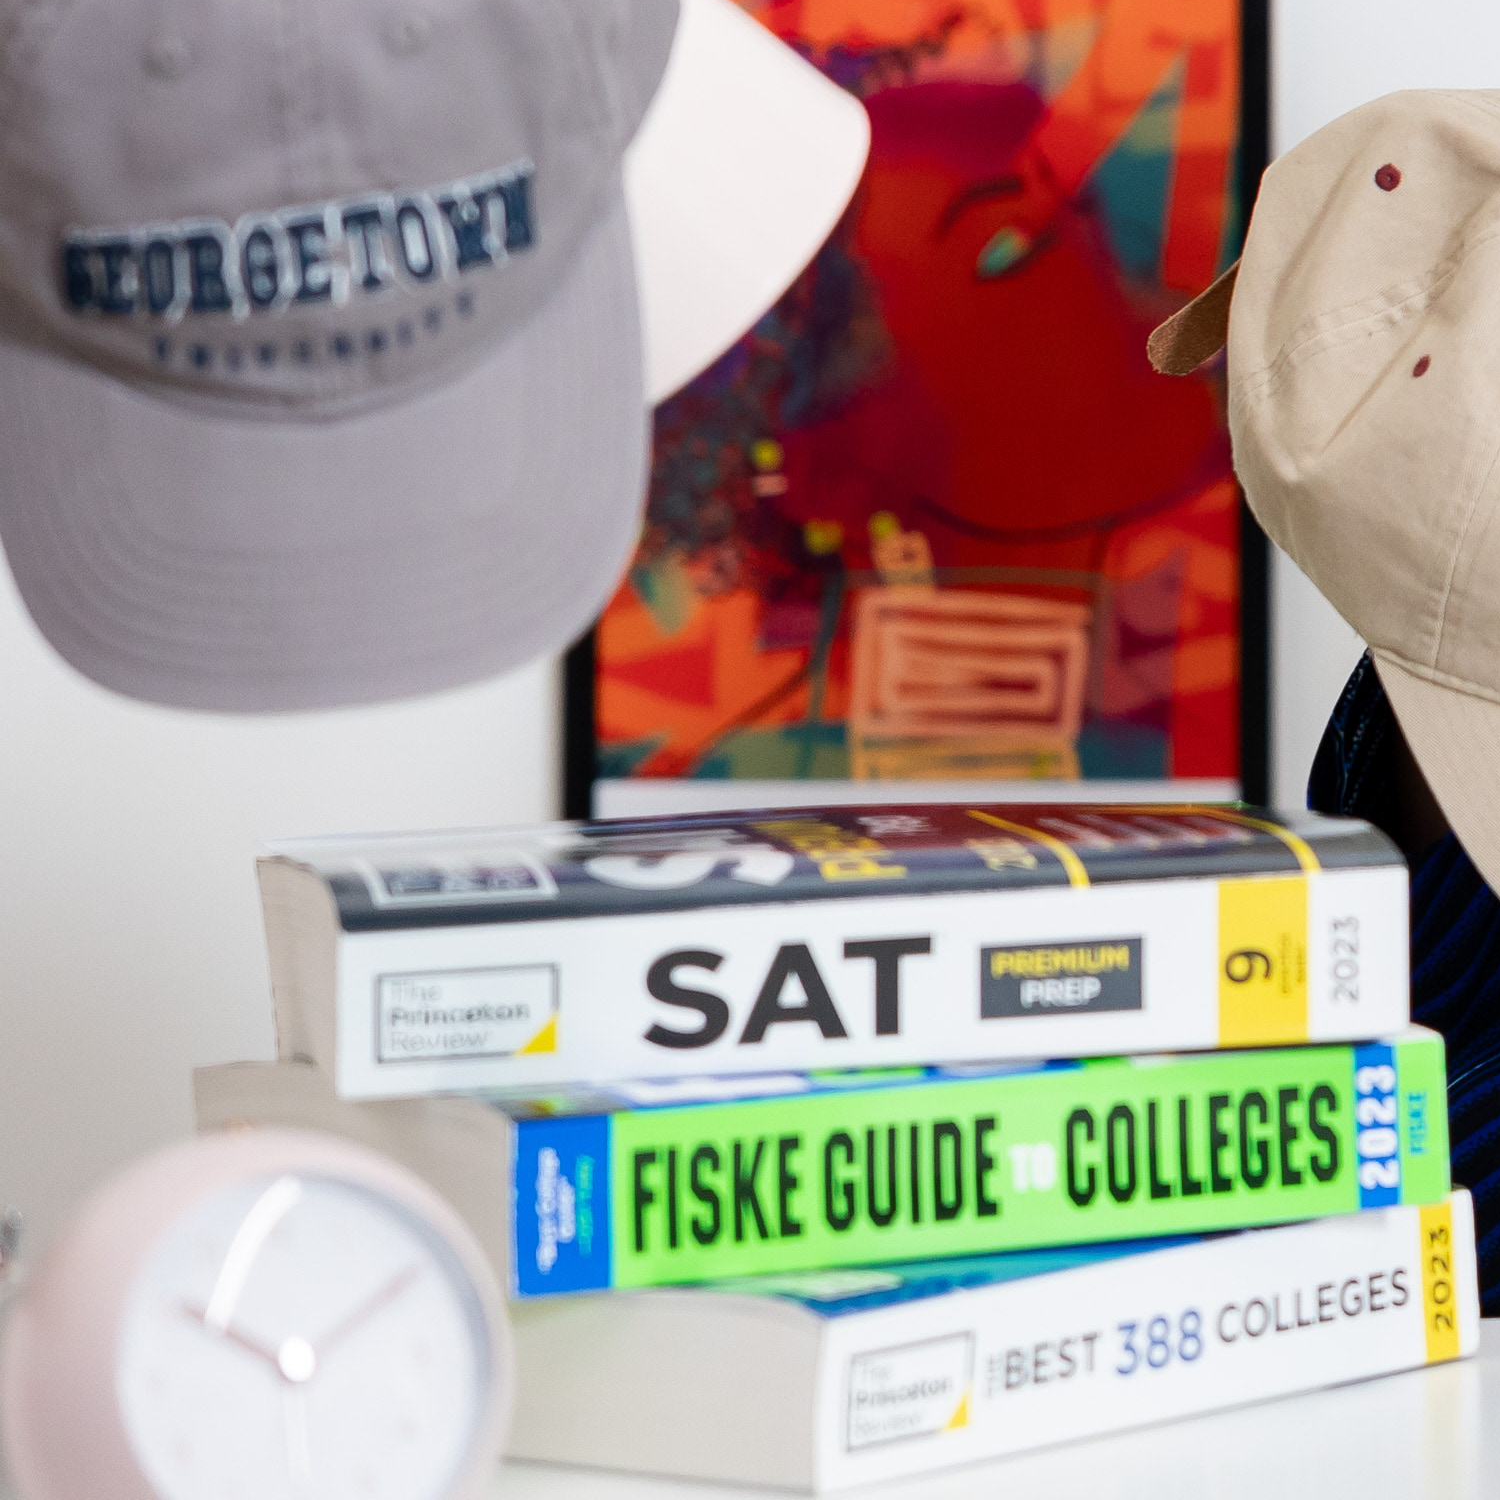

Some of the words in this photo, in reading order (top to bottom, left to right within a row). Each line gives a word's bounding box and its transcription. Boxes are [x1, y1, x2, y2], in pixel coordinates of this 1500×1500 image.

[641, 935, 932, 1050] SAT
[991, 944, 1130, 979] PREMIUM
[1020, 977, 1102, 1008] PREP
[1224, 948, 1271, 985] 9
[1331, 916, 1359, 1003] 2023
[632, 1137, 802, 1253] FISKE
[824, 1117, 998, 1233] GUIDE
[1008, 1142, 1056, 1193] TO
[1066, 1084, 1342, 1207] COLLEGES
[1356, 1064, 1399, 1191] 2023
[1006, 1332, 1101, 1390] BEST
[1115, 1309, 1204, 1375] 388
[1216, 1267, 1411, 1345] COLLEGES
[1428, 1224, 1454, 1332] 2023
